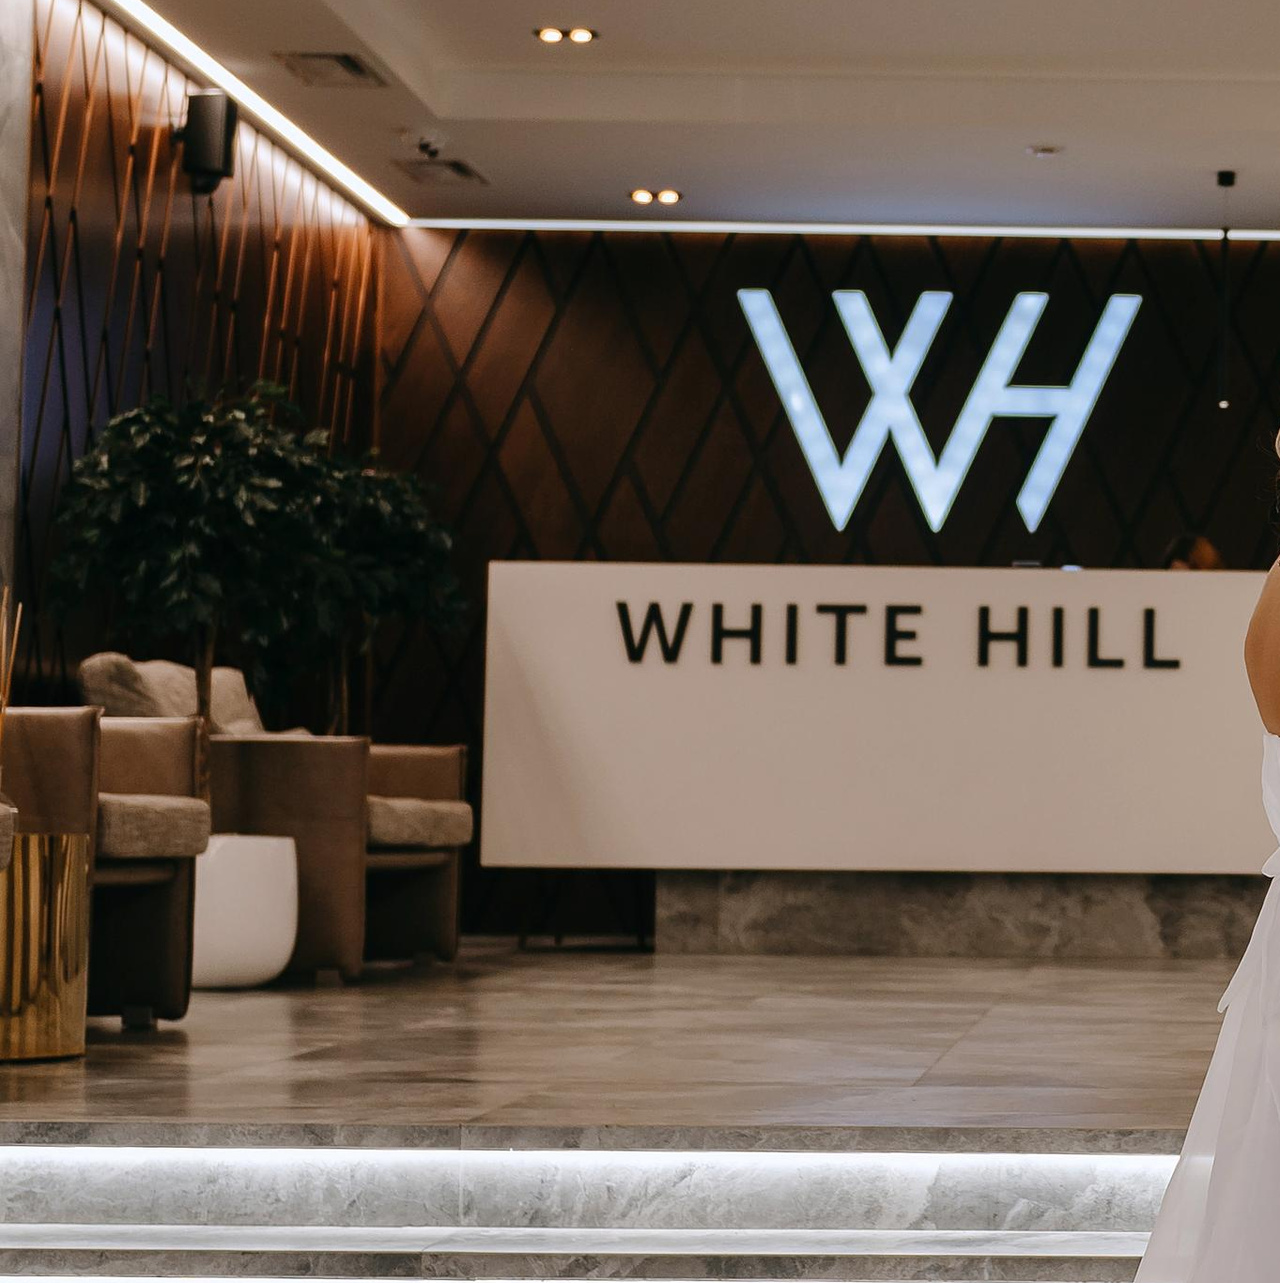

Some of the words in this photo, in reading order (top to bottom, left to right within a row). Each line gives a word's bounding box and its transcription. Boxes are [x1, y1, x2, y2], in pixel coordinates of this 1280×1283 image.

[737, 288, 1143, 533] WH
[615, 601, 925, 666] WHITE
[976, 605, 1182, 669] HILL
